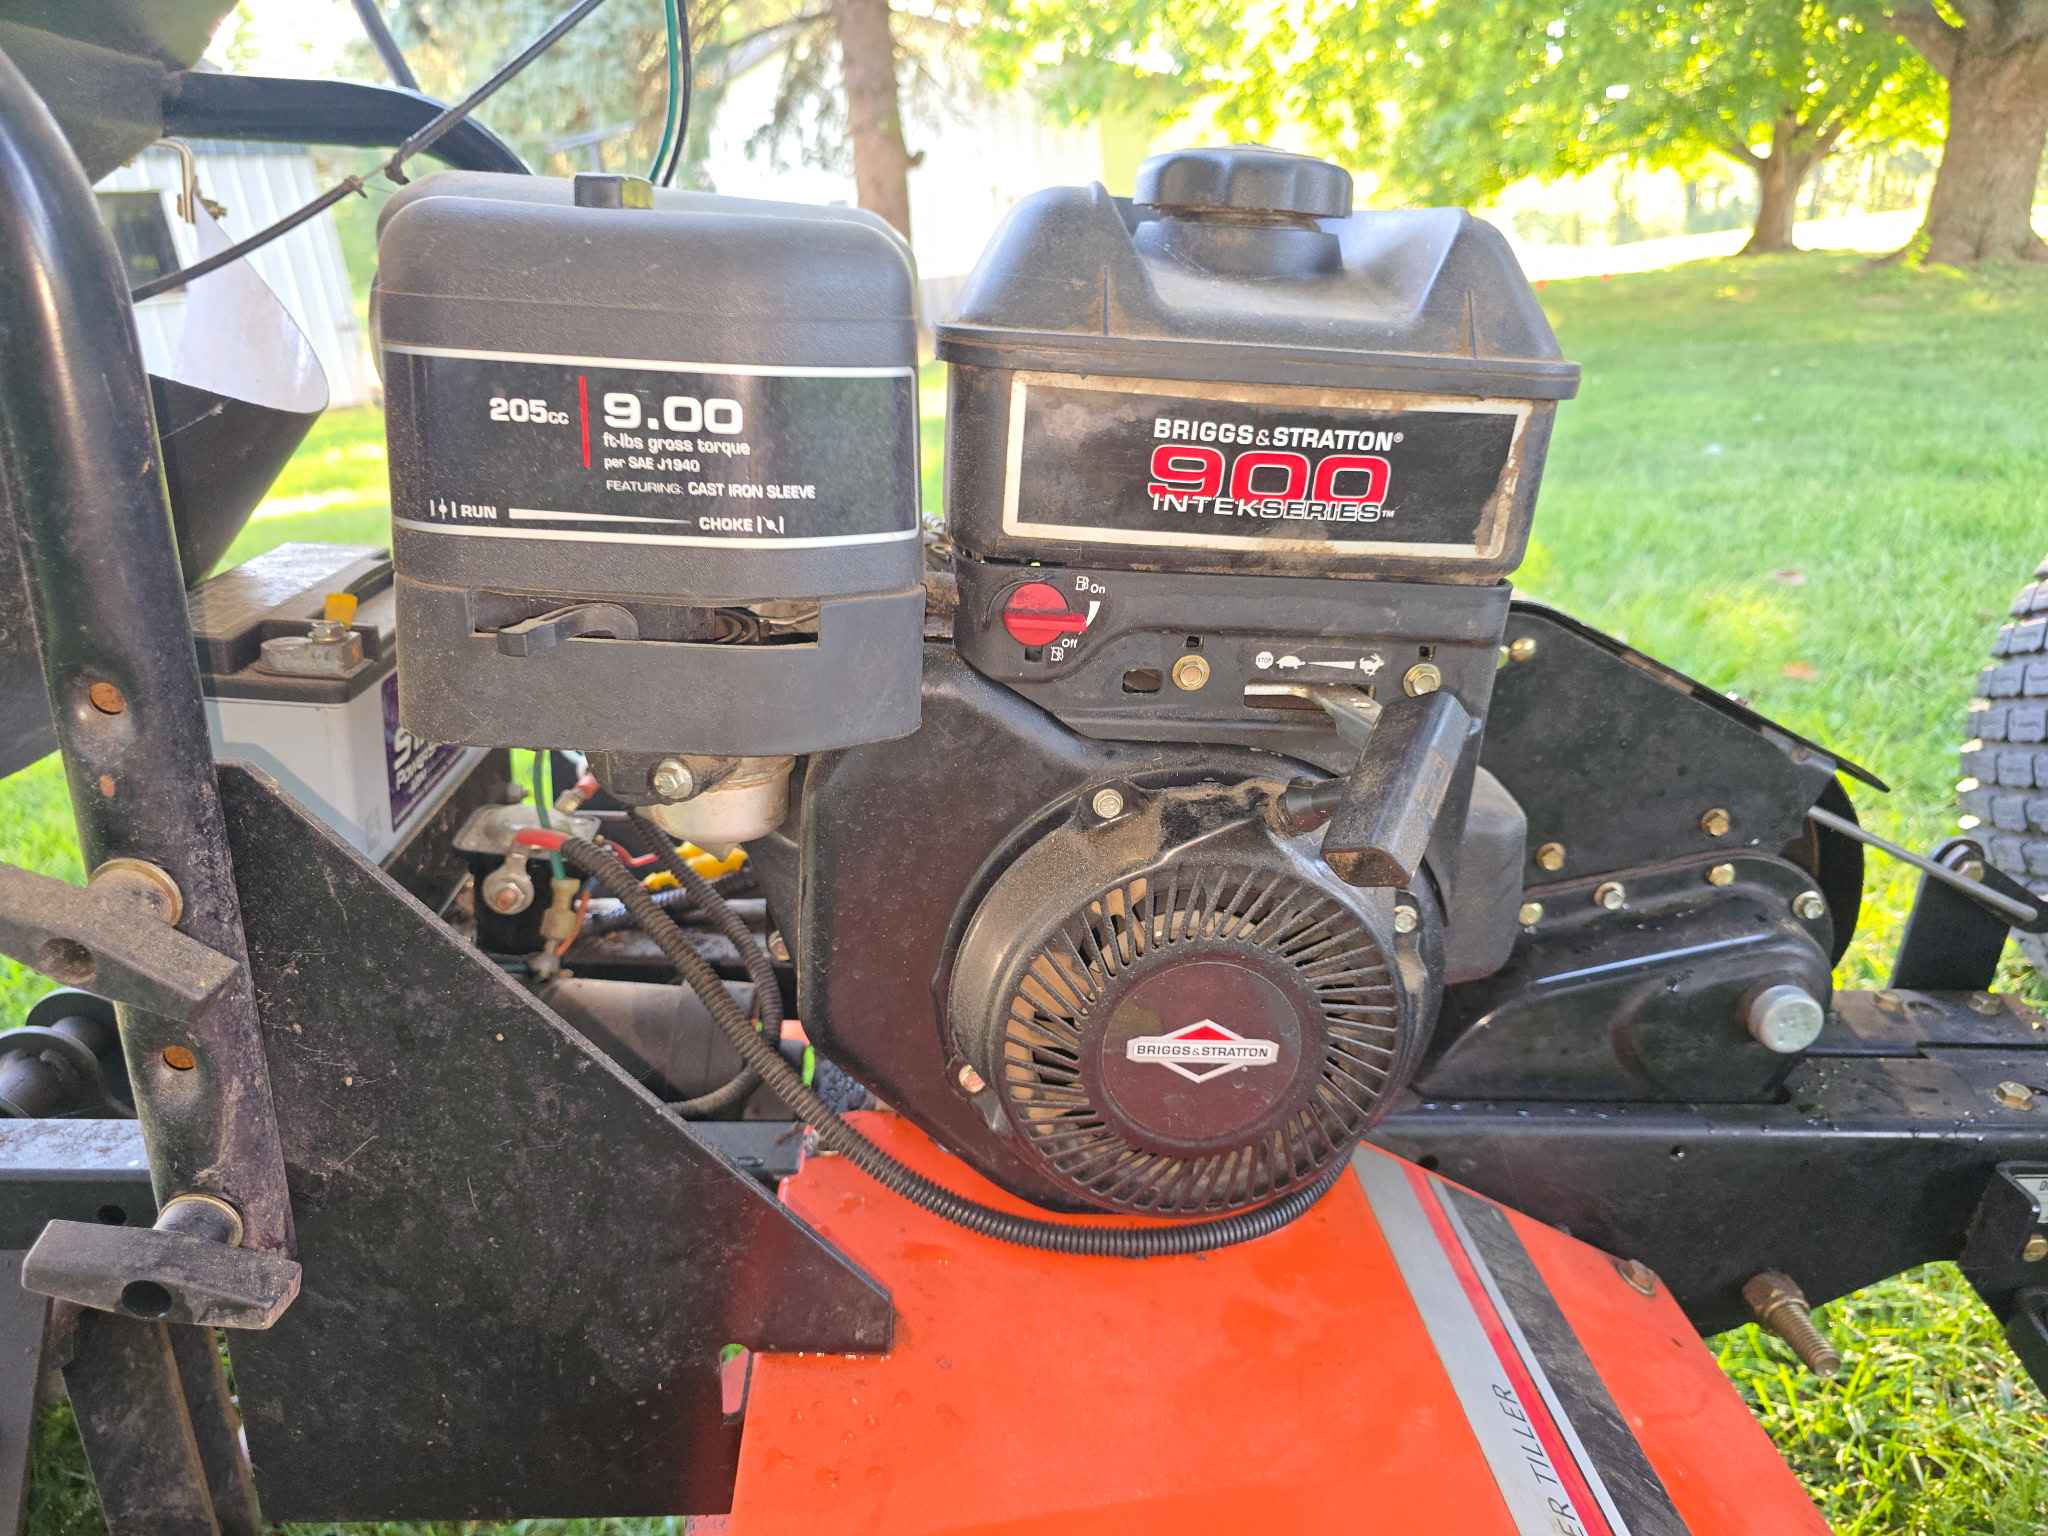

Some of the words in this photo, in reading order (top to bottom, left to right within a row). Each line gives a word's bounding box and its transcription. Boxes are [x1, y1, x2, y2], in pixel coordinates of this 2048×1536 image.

[489, 397, 569, 425] 205cc
[603, 392, 744, 434] 9.00
[603, 432, 644, 449] ft-lbs
[648, 436, 693, 454] gross
[697, 438, 751, 458] torque
[604, 457, 626, 471] per
[628, 456, 654, 470] SAE
[657, 458, 700, 473] J1940
[1148, 443, 1391, 504] 900
[606, 479, 684, 495] FEATURING:
[688, 481, 725, 497] CAST
[728, 483, 763, 499] IRON
[766, 484, 816, 500] SLEEVE
[460, 504, 497, 519] RUN
[699, 516, 753, 532] CHOKE
[1090, 583, 1106, 594] On
[1061, 638, 1078, 649] Off
[1492, 1383, 1558, 1485] TILLER
